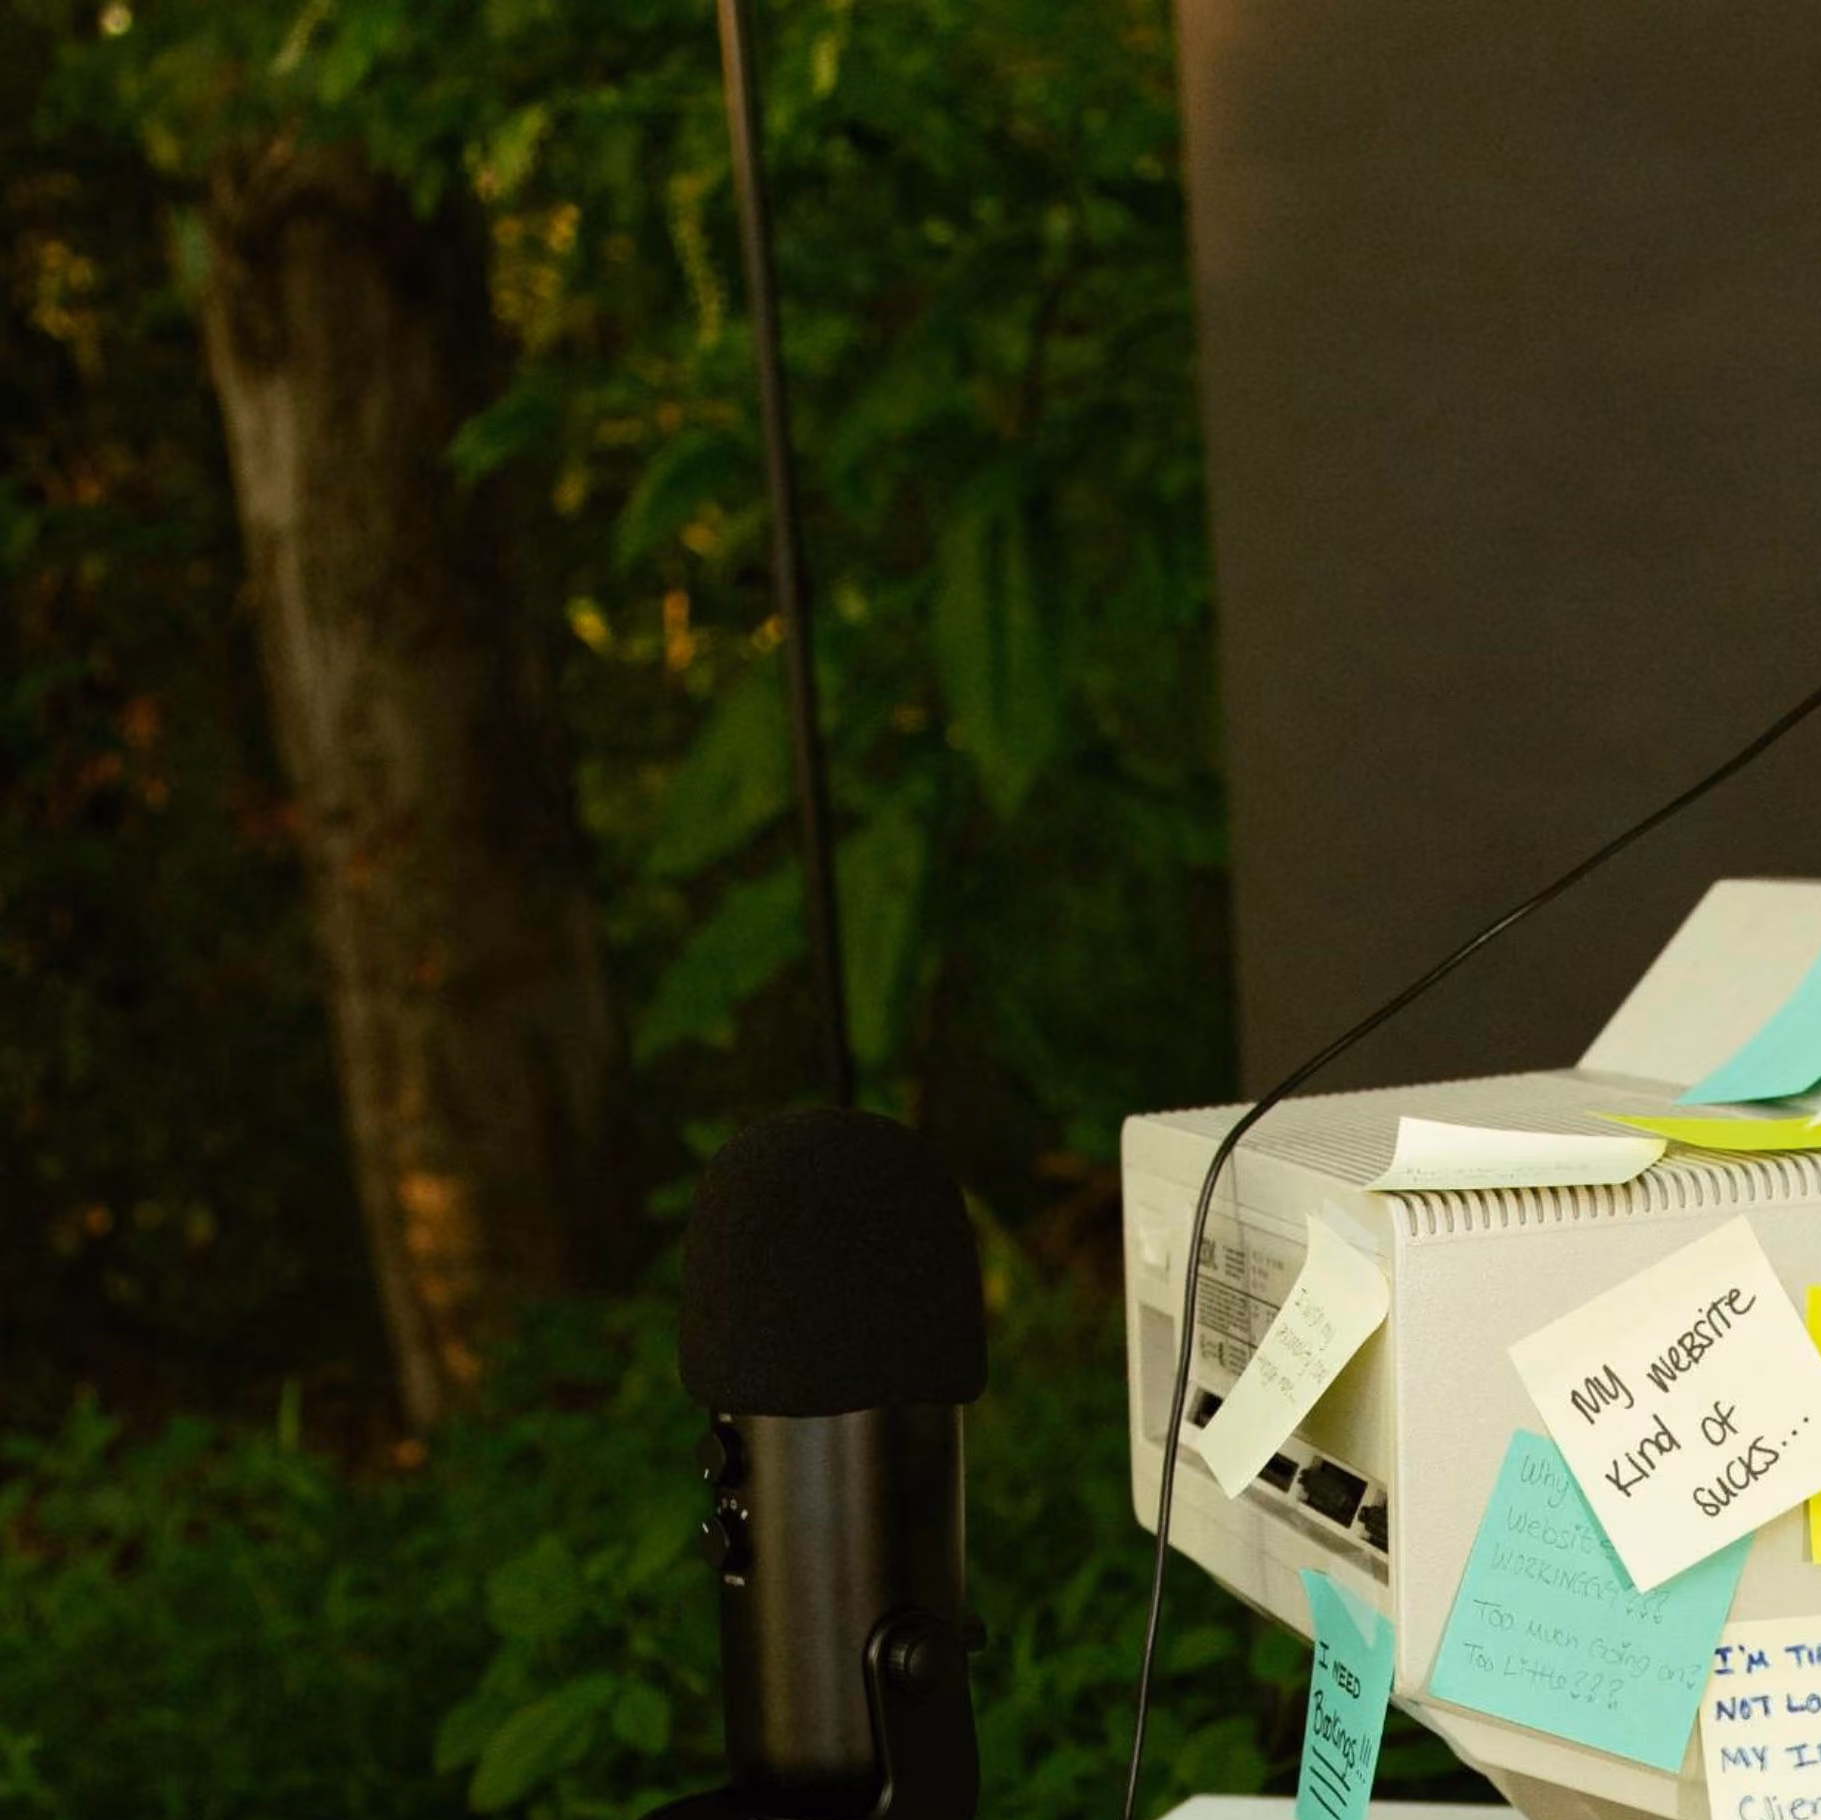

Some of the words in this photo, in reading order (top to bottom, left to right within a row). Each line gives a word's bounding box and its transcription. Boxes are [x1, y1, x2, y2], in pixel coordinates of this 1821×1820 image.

[1520, 1454, 1569, 1508] Why
[1473, 1598, 1514, 1631] Too
[1318, 1640, 1330, 1671] I
[1332, 1658, 1362, 1699] NEED
[1464, 1642, 1494, 1673] Too
[1714, 1644, 1769, 1675] I'M
[1715, 1694, 1771, 1722] NOT
[1720, 1746, 1768, 1773] MY
